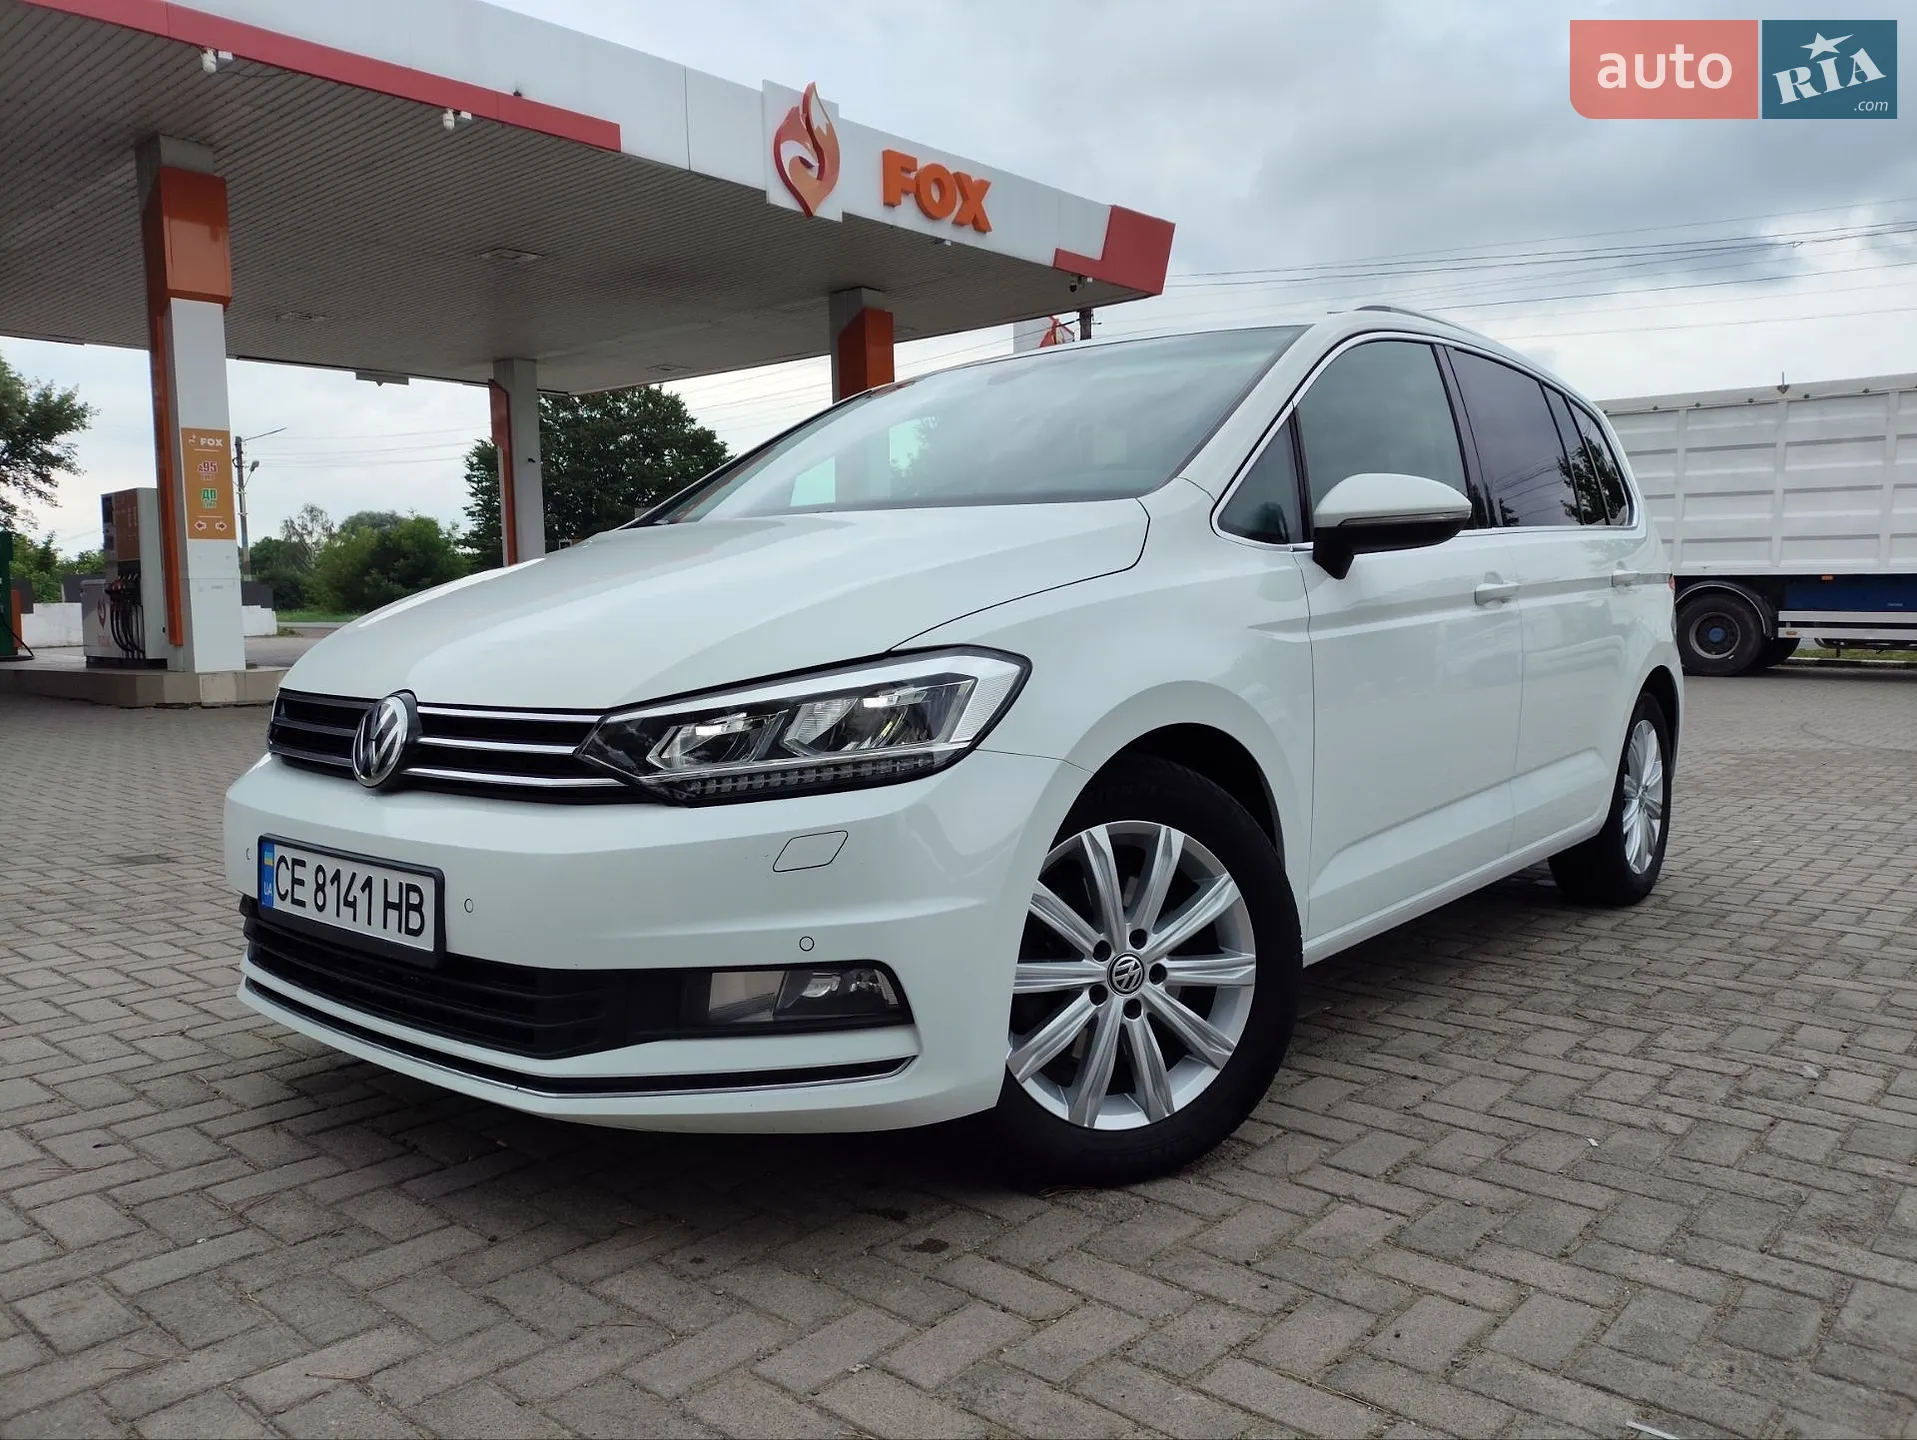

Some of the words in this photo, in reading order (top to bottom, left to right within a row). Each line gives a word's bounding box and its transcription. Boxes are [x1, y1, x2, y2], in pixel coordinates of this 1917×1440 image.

[881, 148, 992, 233] FOX
[200, 437, 224, 447] FOX
[263, 881, 273, 896] UA
[275, 854, 307, 909] CE
[314, 864, 374, 926] 8141
[382, 878, 426, 937] HB
